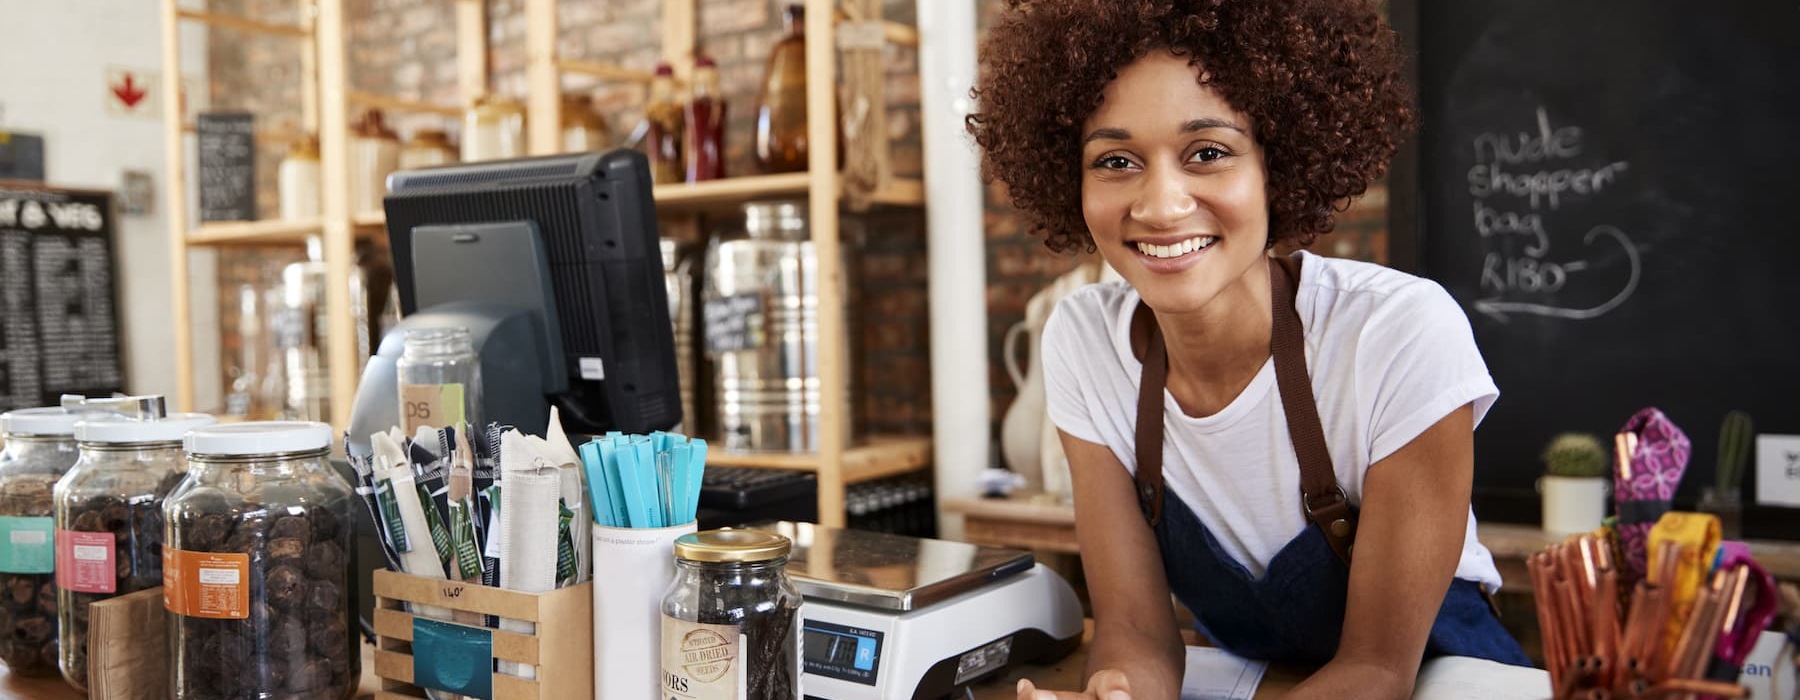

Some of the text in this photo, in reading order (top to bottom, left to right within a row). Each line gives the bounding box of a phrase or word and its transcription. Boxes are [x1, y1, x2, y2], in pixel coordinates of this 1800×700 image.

[1473, 105, 1583, 163] nude
[47, 202, 103, 231] VEG
[1473, 200, 1550, 258] bag
[685, 647, 729, 663] AIR DRIED
[861, 648, 870, 660] R
